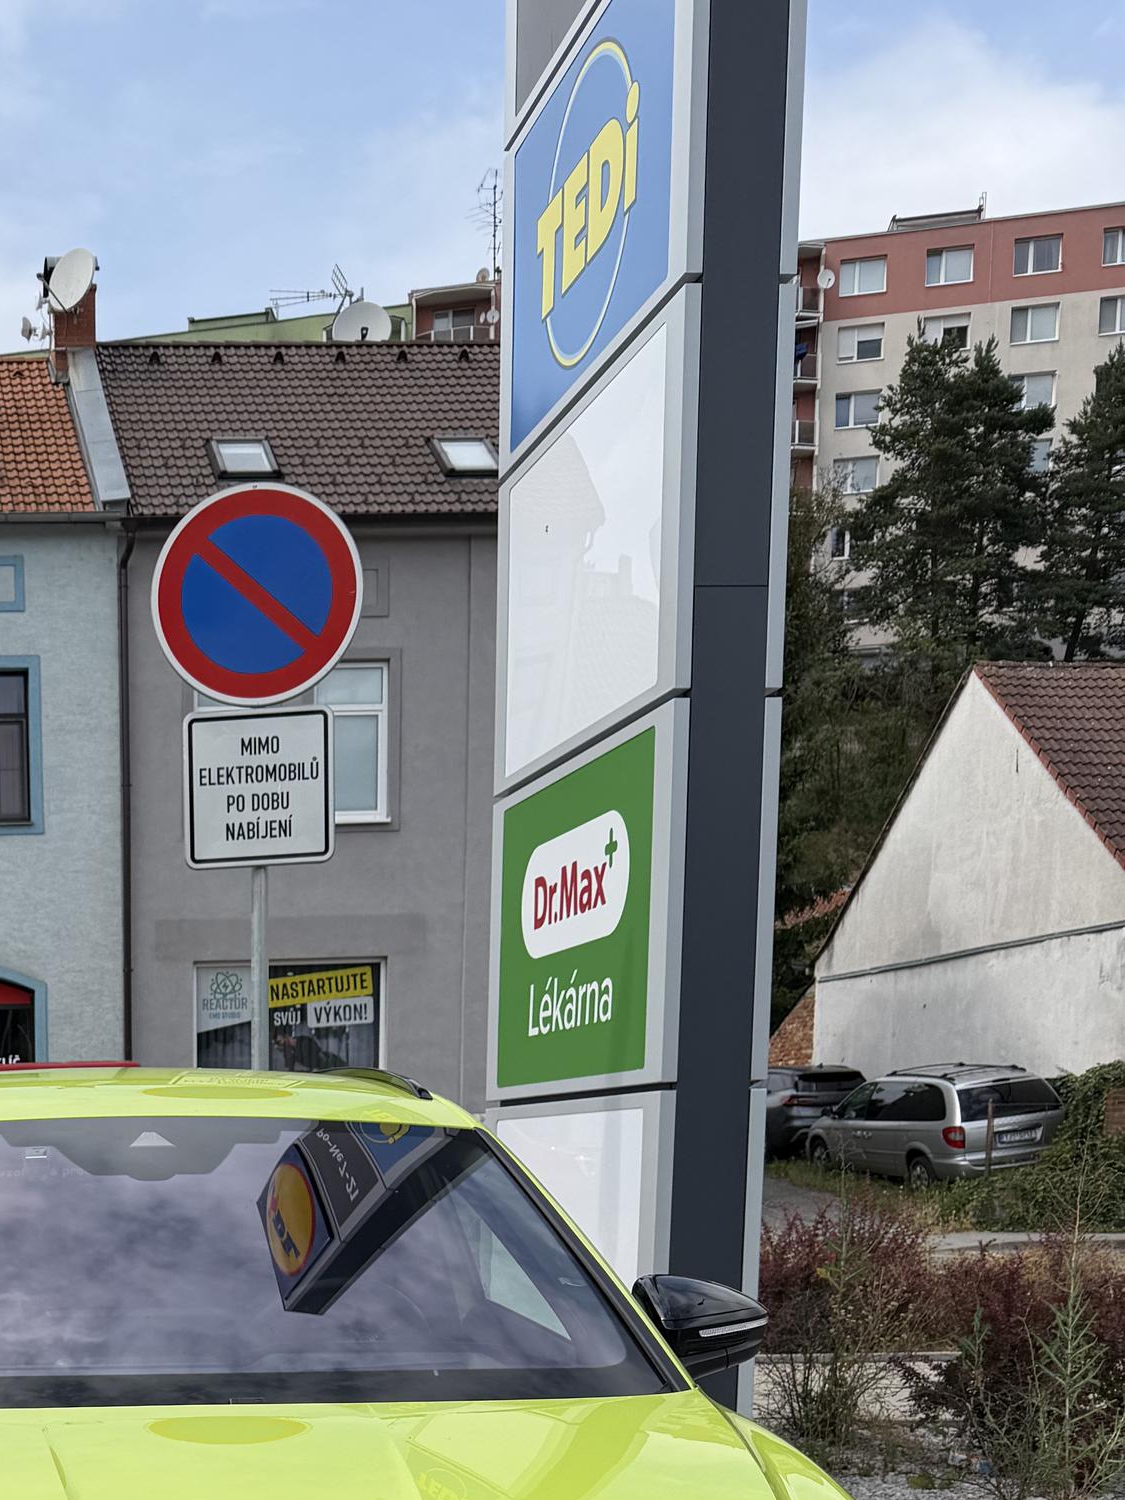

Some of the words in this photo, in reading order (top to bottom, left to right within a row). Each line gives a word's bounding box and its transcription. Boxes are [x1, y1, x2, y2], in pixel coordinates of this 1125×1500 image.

[240, 735, 280, 756] MIMO
[199, 756, 320, 787] ELEKTROMOBILŮ
[226, 793, 246, 814] PO
[251, 791, 290, 811] DOBU
[225, 815, 293, 841] NABÍJENÍ
[533, 861, 607, 930] Dr.Max
[270, 972, 368, 1002] NASTARTUJTE
[314, 1001, 368, 1024] VÝKON!
[528, 968, 613, 1037] Lékárna
